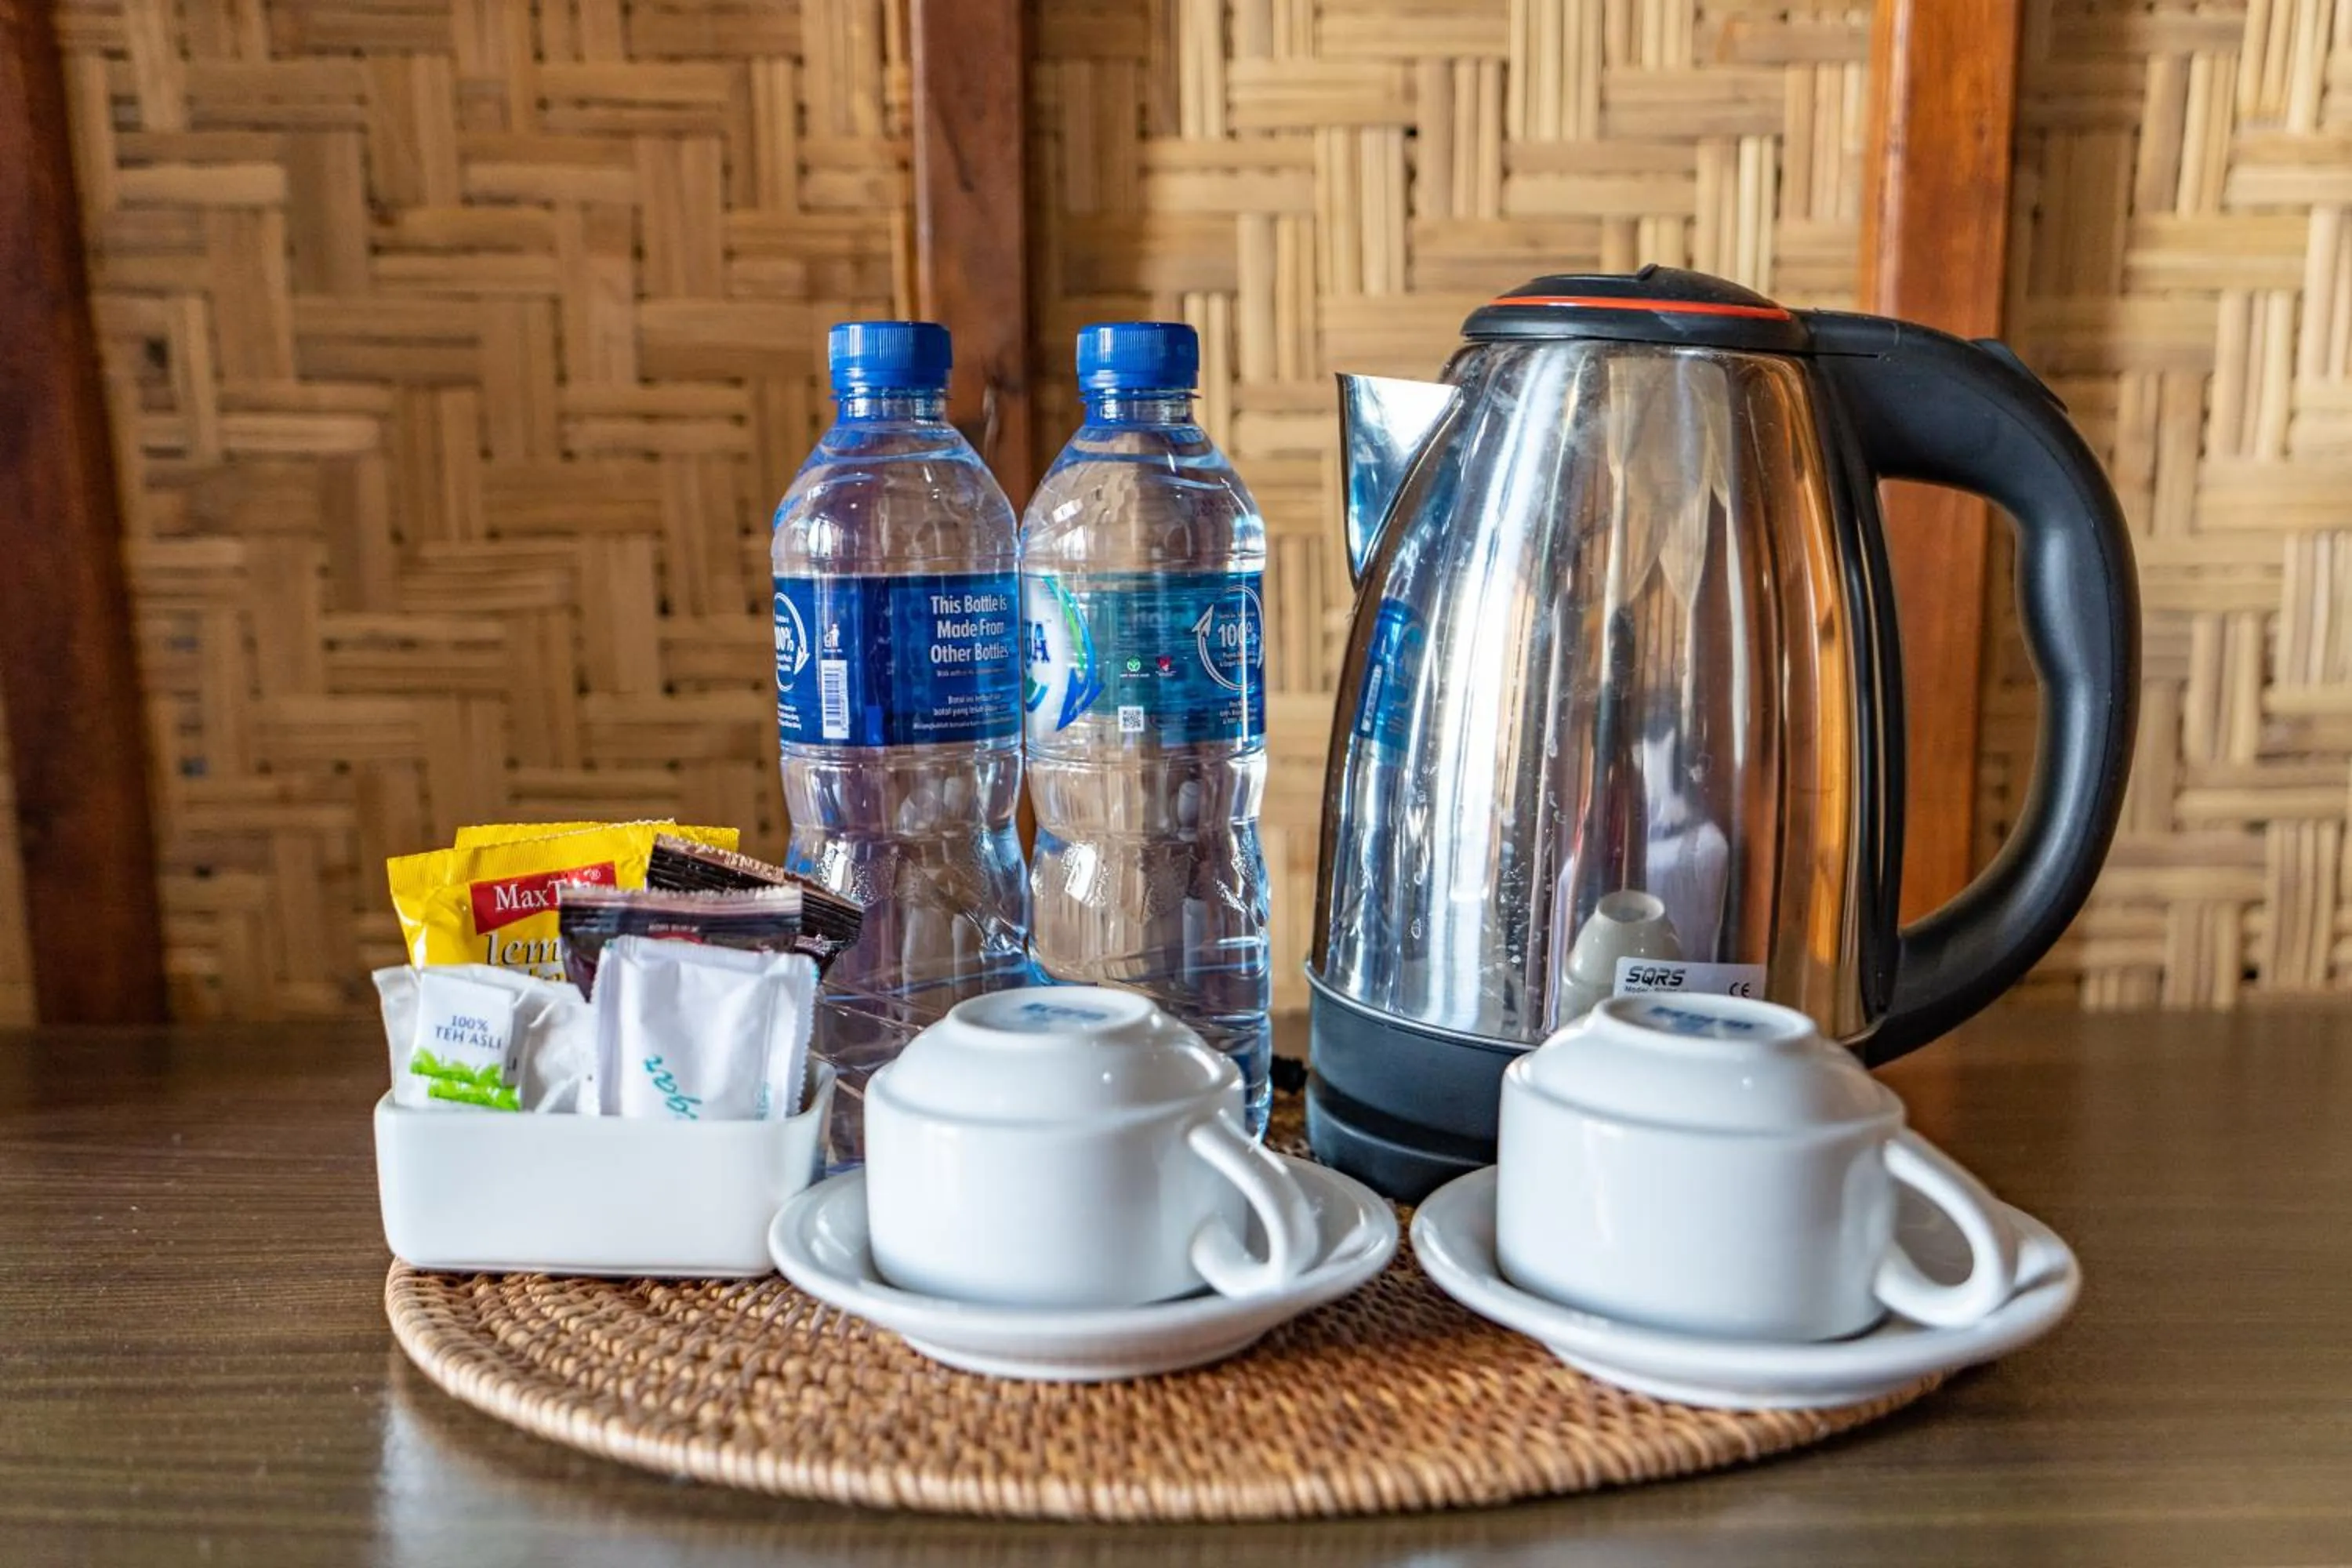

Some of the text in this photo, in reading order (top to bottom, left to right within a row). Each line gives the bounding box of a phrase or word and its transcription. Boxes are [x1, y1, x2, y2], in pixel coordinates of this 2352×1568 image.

[930, 593, 1007, 615] This Bottle Is
[937, 618, 1004, 639] Made From
[930, 641, 1010, 664] Other Bottles
[485, 928, 565, 967] lem
[1625, 965, 1686, 986] SQRS
[451, 1014, 490, 1032] 100%
[435, 1025, 503, 1051] TEH ASLI
